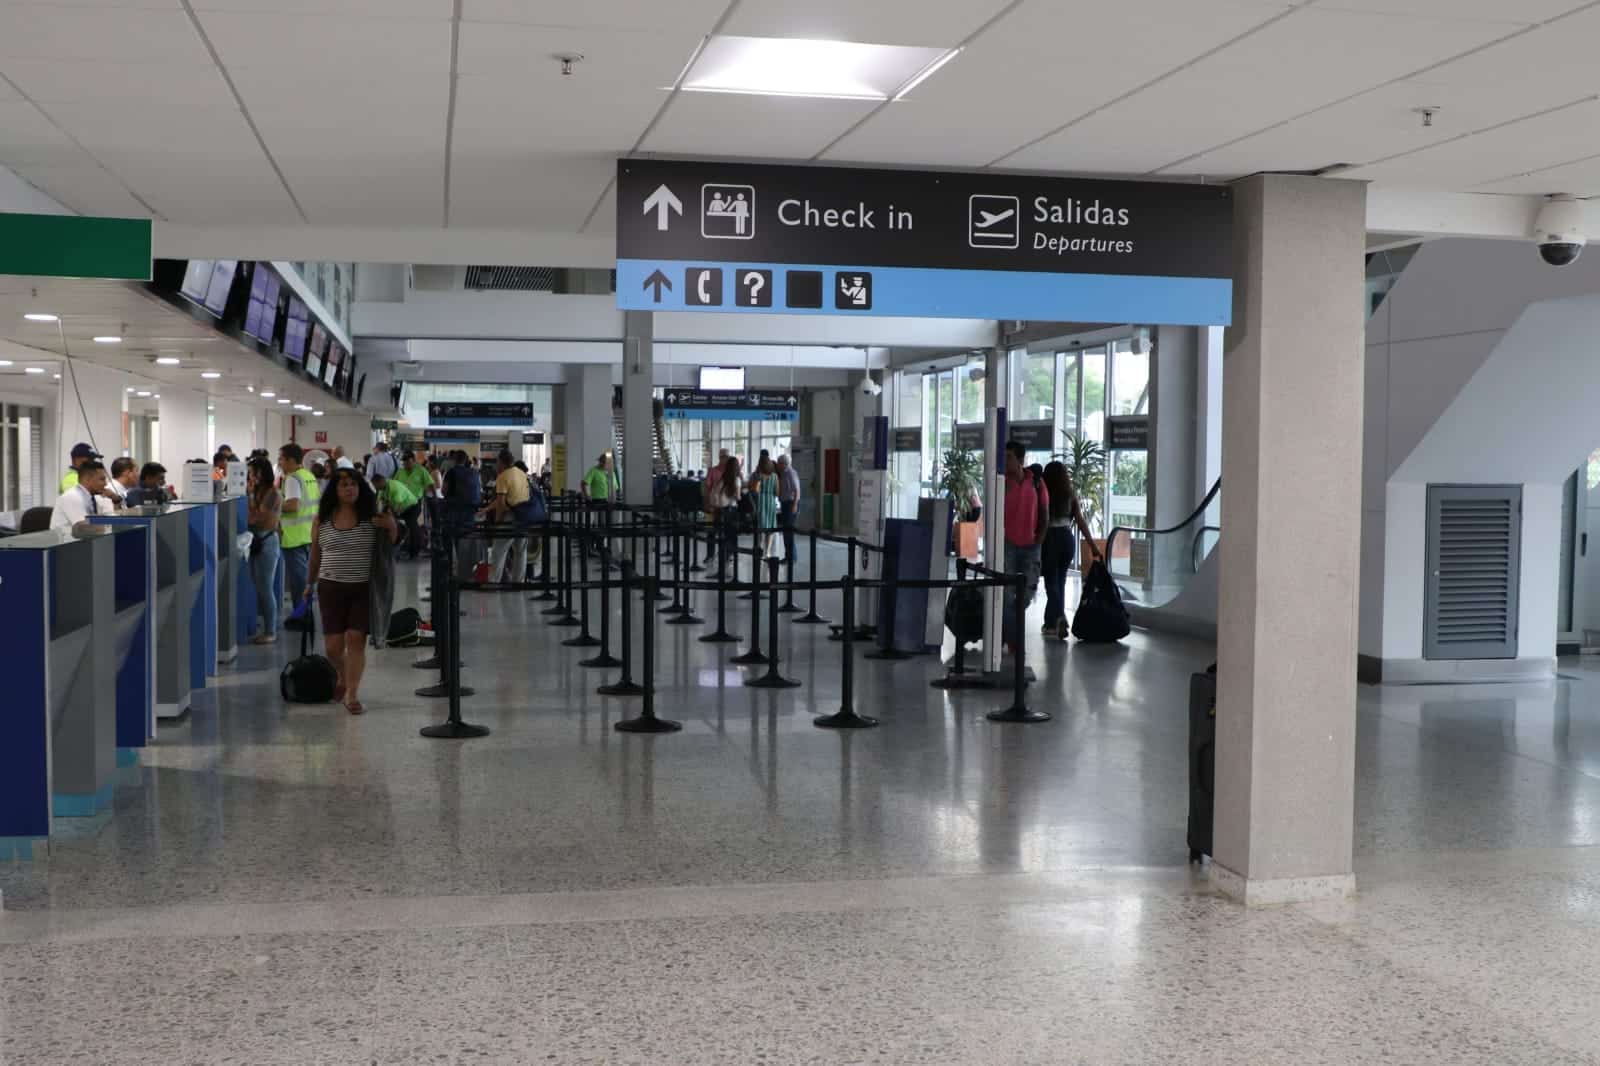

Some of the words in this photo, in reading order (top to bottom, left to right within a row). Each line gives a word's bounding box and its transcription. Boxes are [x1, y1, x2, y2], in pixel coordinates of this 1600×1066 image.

[777, 199, 875, 229] Check
[888, 204, 914, 231] in
[1034, 197, 1130, 226] Salidas
[1033, 233, 1135, 256] Departures
